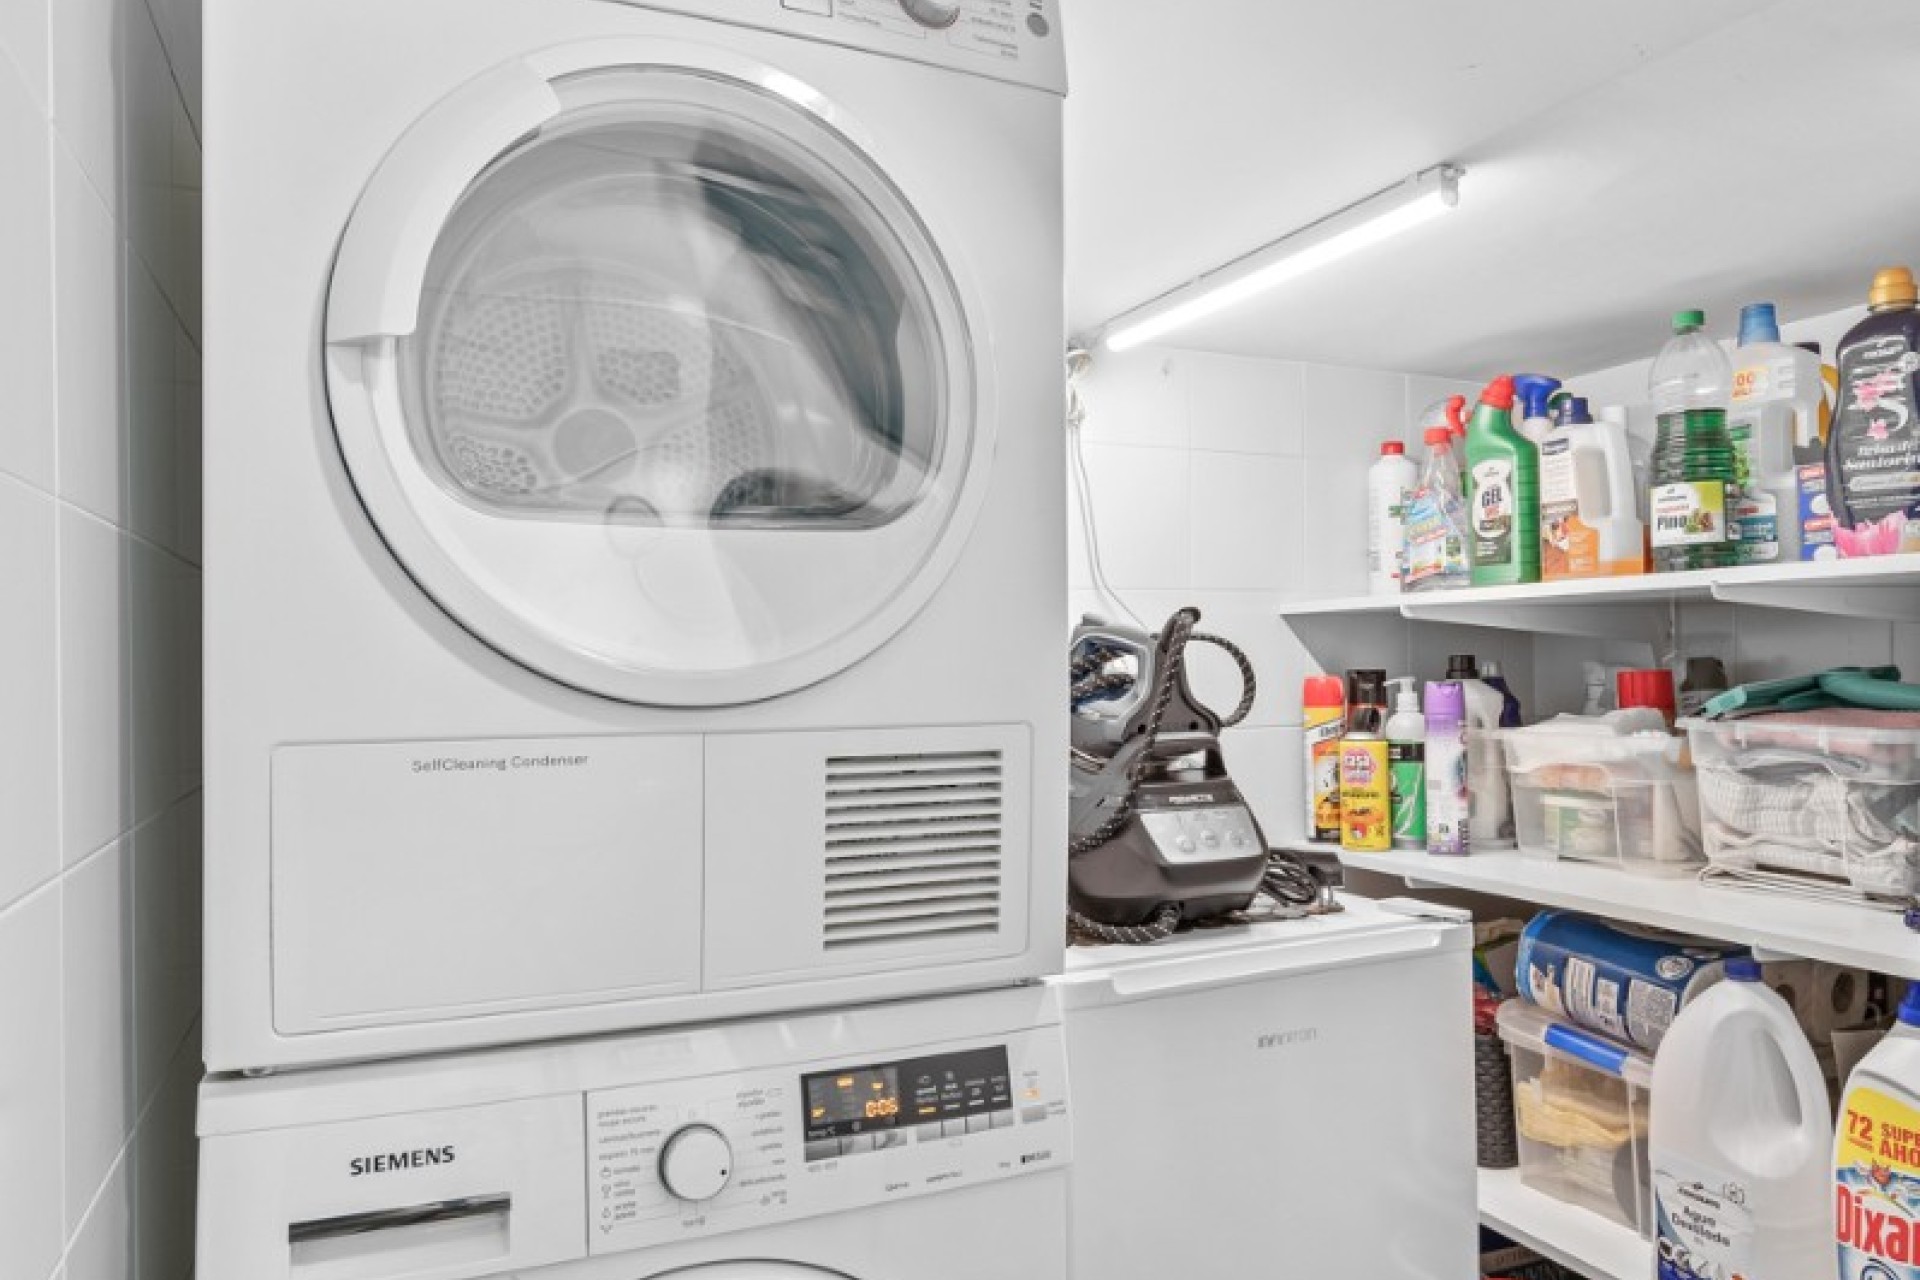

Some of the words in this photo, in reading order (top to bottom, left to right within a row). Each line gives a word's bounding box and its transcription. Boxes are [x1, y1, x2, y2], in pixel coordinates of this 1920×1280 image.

[411, 757, 506, 773] SelfCleaning
[511, 754, 589, 768] Condenser
[1847, 1109, 1873, 1142] 72
[350, 1145, 456, 1177] SIEMENS
